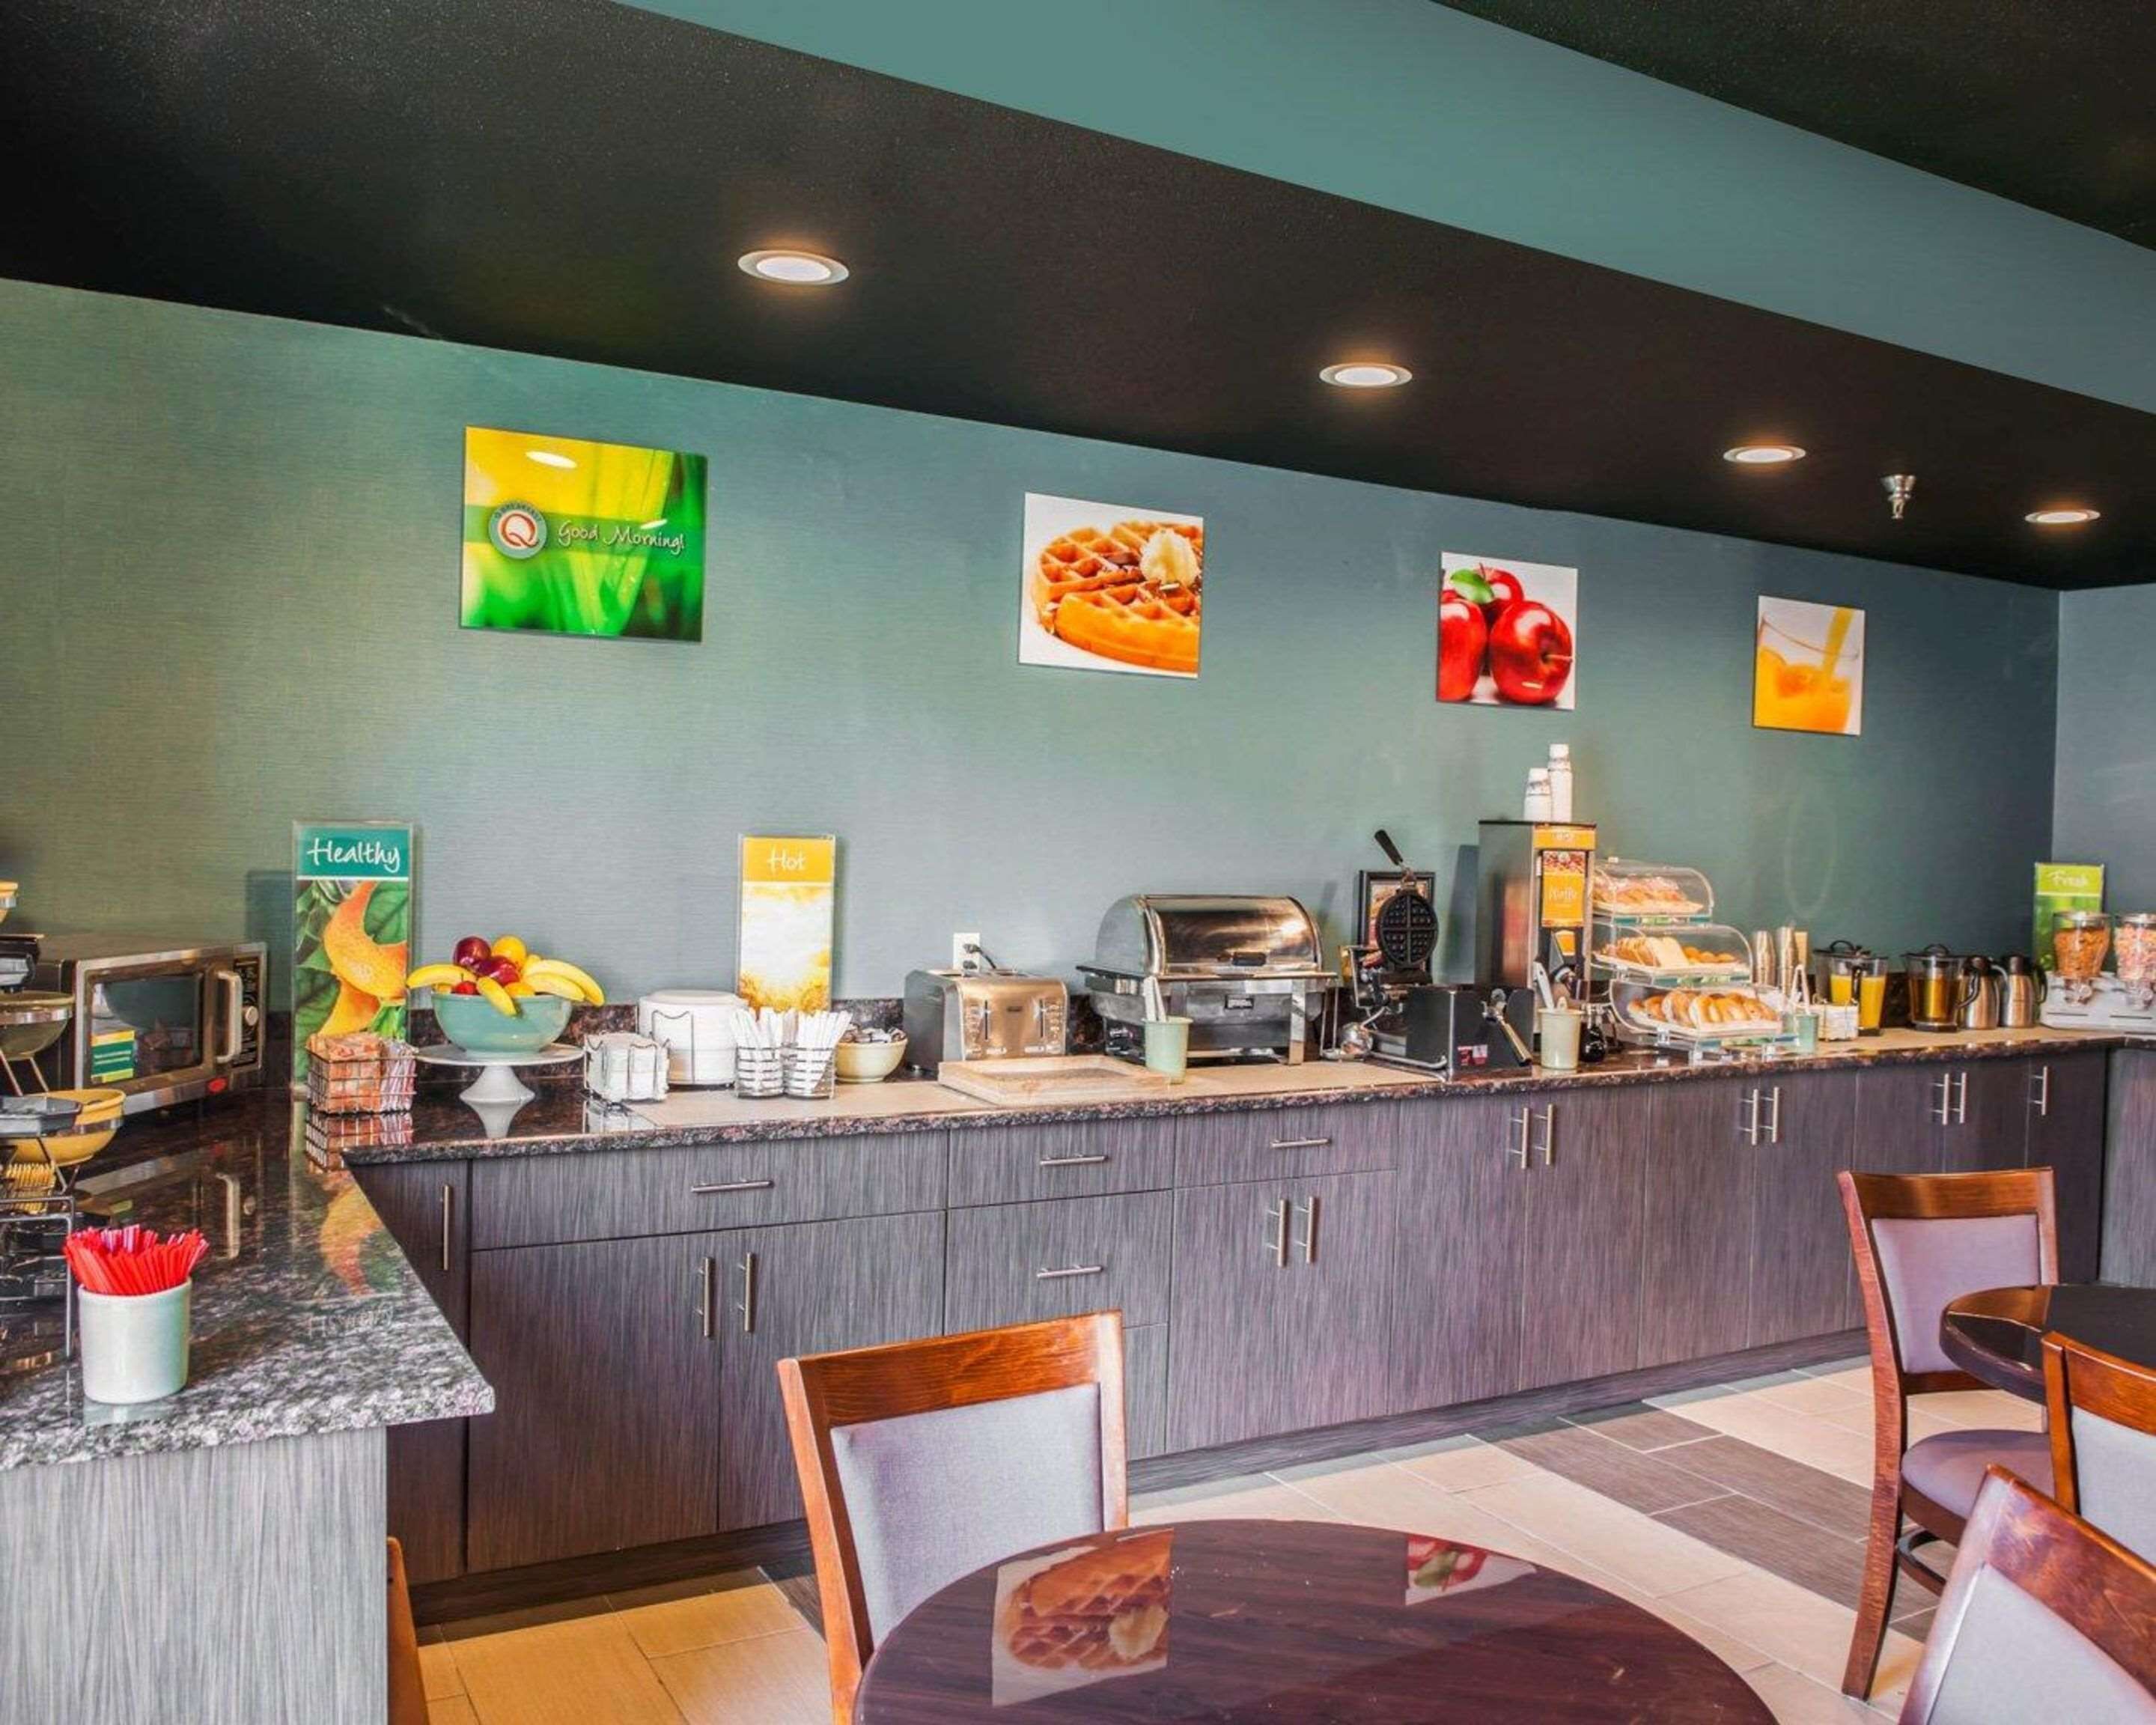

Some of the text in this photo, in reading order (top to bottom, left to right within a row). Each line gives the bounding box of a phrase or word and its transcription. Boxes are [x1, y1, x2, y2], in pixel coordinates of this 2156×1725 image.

[501, 513, 540, 548] Q
[558, 520, 684, 555] Good Morning!
[306, 837, 401, 874] Healthy
[767, 845, 807, 874] Hot
